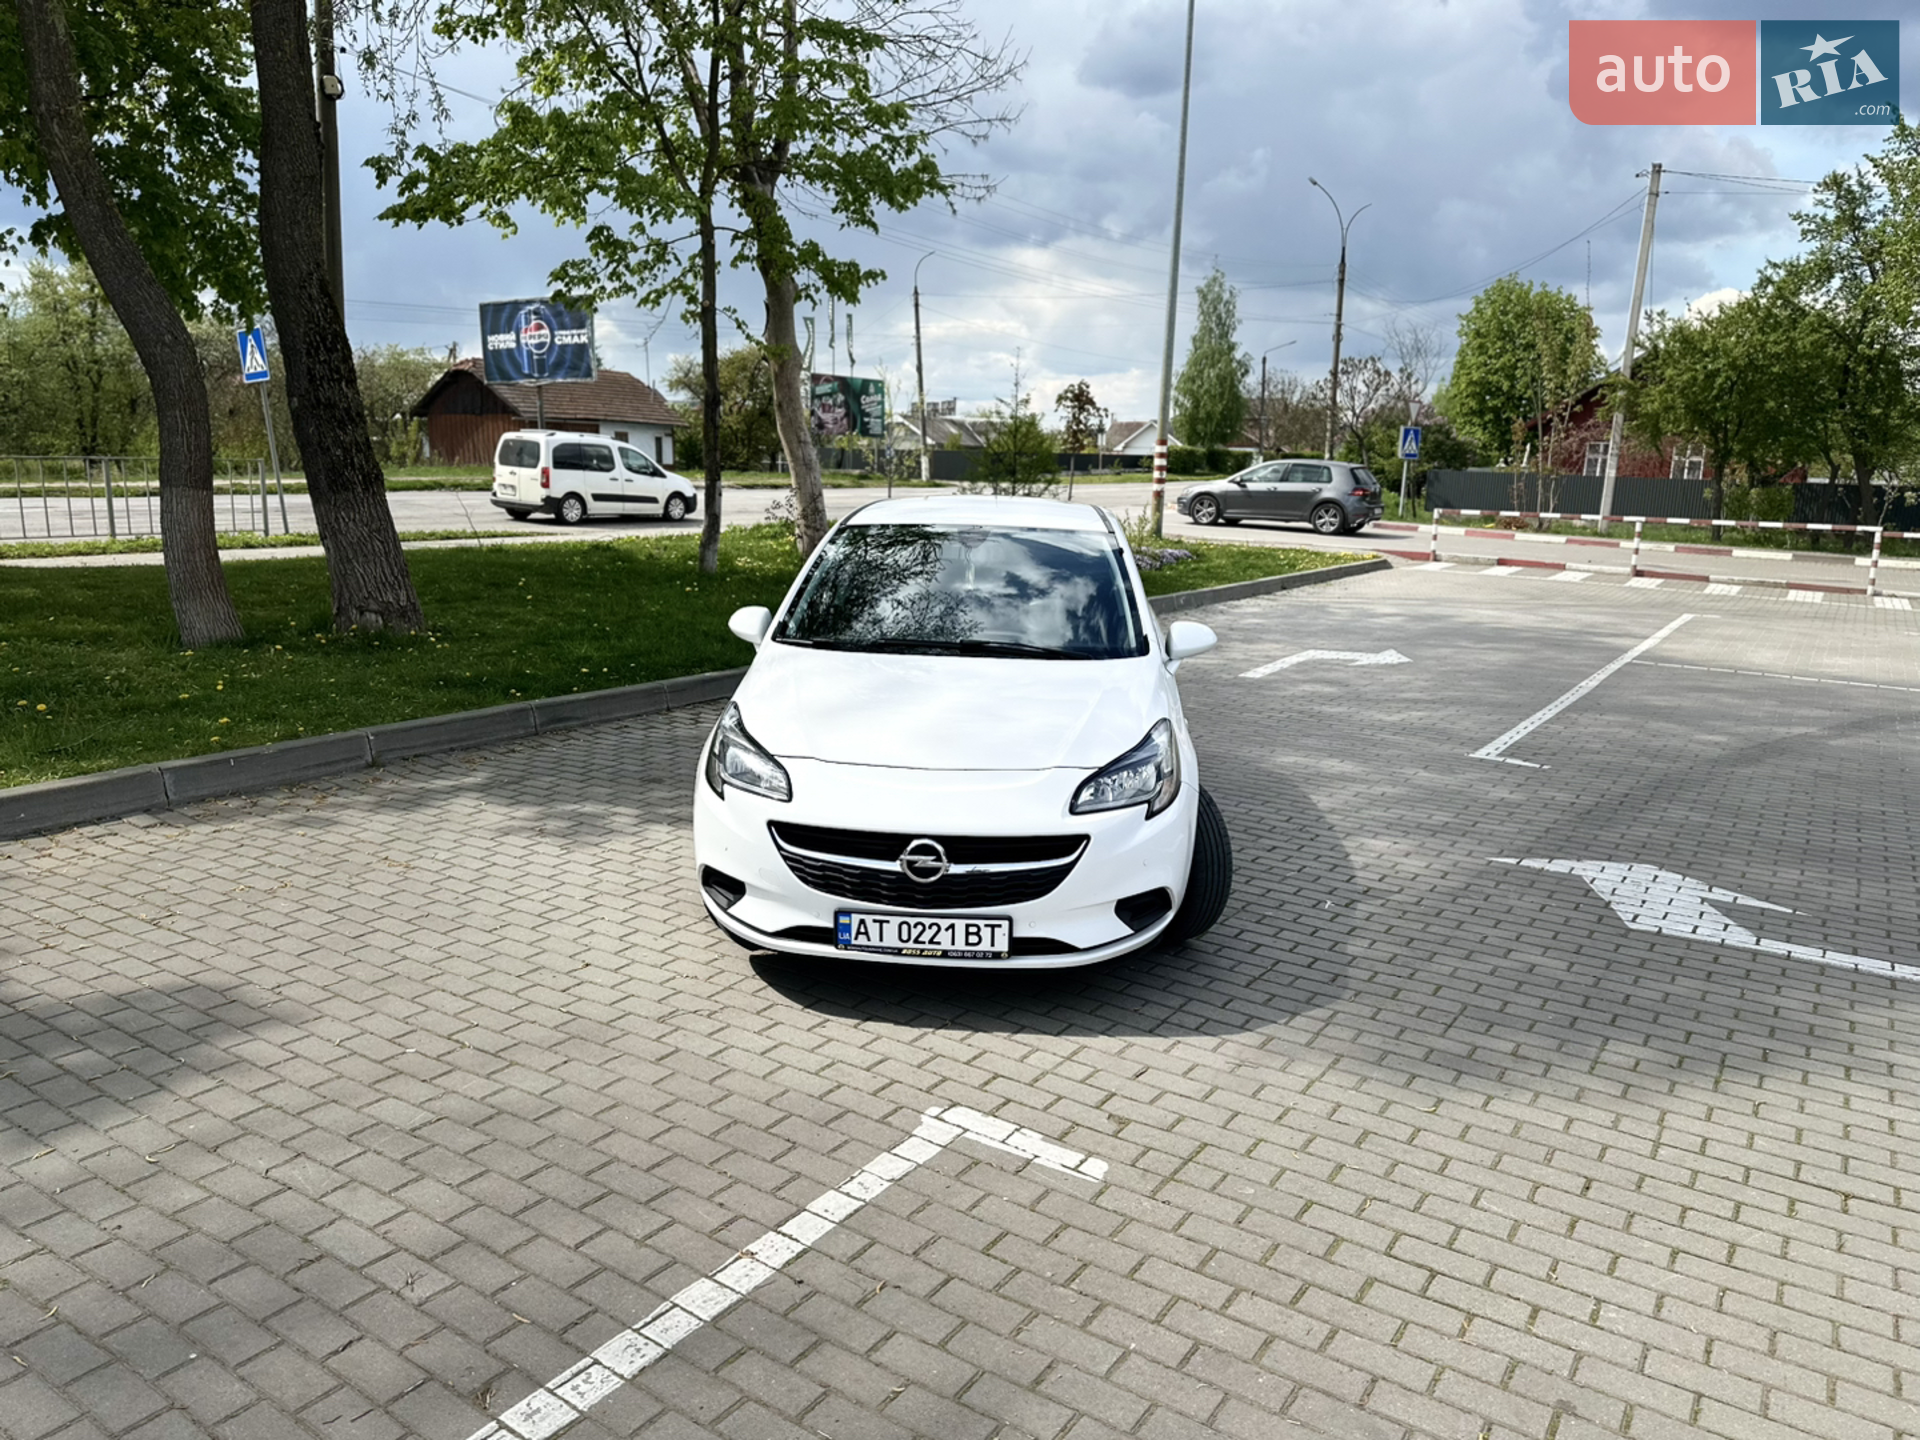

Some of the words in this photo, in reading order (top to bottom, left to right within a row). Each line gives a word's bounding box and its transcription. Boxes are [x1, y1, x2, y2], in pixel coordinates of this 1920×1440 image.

[554, 334, 589, 345] СМАК
[838, 931, 850, 940] UA
[853, 918, 890, 943] AT
[897, 920, 956, 946] 0221
[964, 923, 1002, 948] BT
